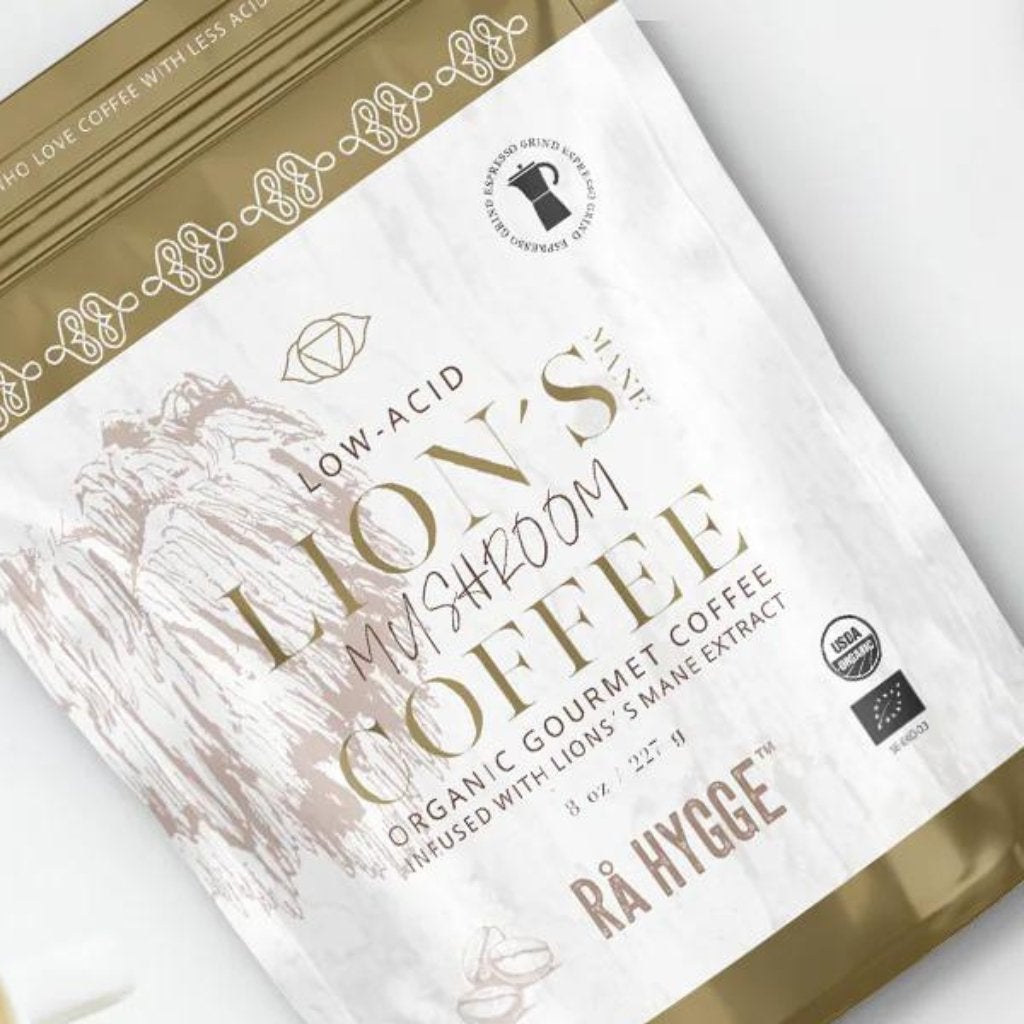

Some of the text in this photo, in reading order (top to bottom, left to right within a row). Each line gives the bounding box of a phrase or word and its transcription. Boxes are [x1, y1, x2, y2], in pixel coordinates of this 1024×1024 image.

[32, 128, 77, 166] LOVE
[78, 83, 140, 133] COFFEE
[140, 50, 187, 88] WITH
[187, 22, 226, 56] LESS
[520, 138, 560, 150] GRIND
[484, 144, 518, 195] ESPRESSO
[484, 199, 510, 238] GRIND
[571, 203, 596, 240] GRIND
[510, 236, 569, 253] ESPRESSO
[297, 364, 464, 494] LOW-ACID
[345, 458, 629, 681] MUSHROOM
[339, 484, 750, 805] COFFEE
[830, 626, 862, 654] USDA
[388, 564, 773, 847] ORGANIC GOURMET COFFEE
[404, 806, 492, 873] INFUSED
[492, 766, 549, 811] WITH
[638, 656, 702, 709] MANE
[701, 592, 786, 664] EXTRACT
[564, 800, 580, 817] 8
[586, 782, 610, 803] oz
[627, 738, 662, 773] 227
[570, 860, 652, 940] RÅ
[629, 757, 788, 898] HYGGE
